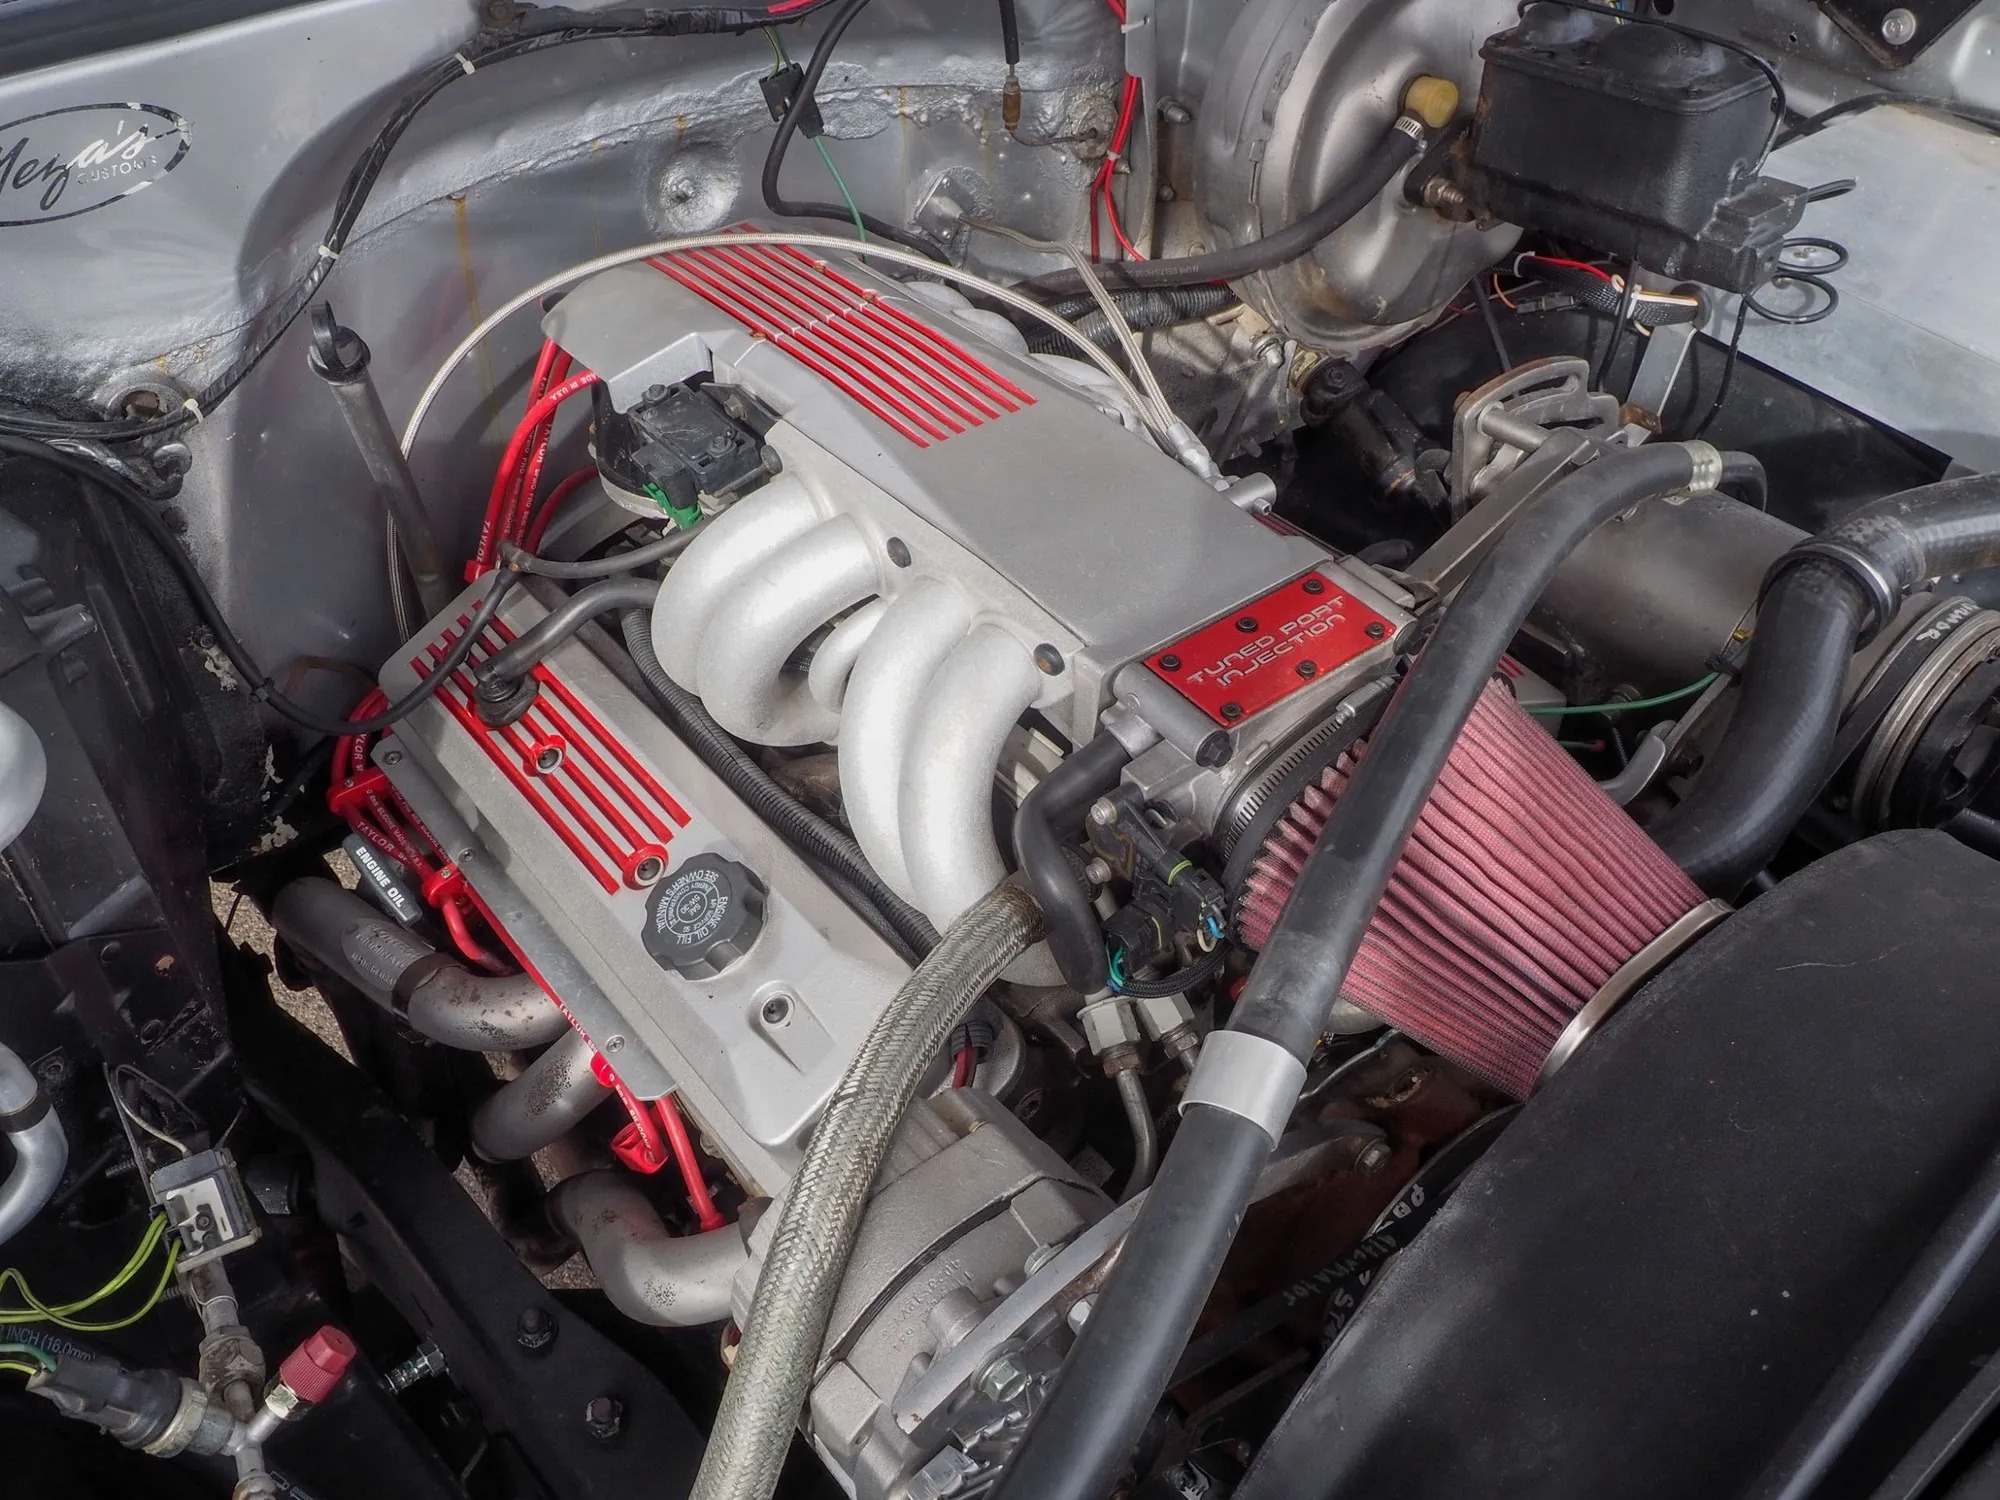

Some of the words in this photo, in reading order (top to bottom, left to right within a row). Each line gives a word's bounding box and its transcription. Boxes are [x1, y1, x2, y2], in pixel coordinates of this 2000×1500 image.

[580, 373, 597, 384] ADE
[1186, 633, 1275, 683] TUNED
[1279, 595, 1344, 634] PORT
[1215, 613, 1346, 688] INJECTION
[354, 734, 367, 760] YLOR
[357, 822, 394, 852] TAYLOR
[355, 846, 390, 888] ENGINE
[387, 887, 406, 908] OIL
[665, 870, 704, 897] OWNER'S
[704, 870, 719, 883] SEE
[656, 896, 669, 934] MANUAL
[680, 894, 700, 914] 5W-30
[690, 903, 701, 916] SAE
[708, 896, 728, 929] ENGINE
[693, 910, 714, 930] SERVICE
[677, 934, 692, 945] FILL
[696, 926, 709, 940] OIL
[7, 1325, 40, 1345] INCH
